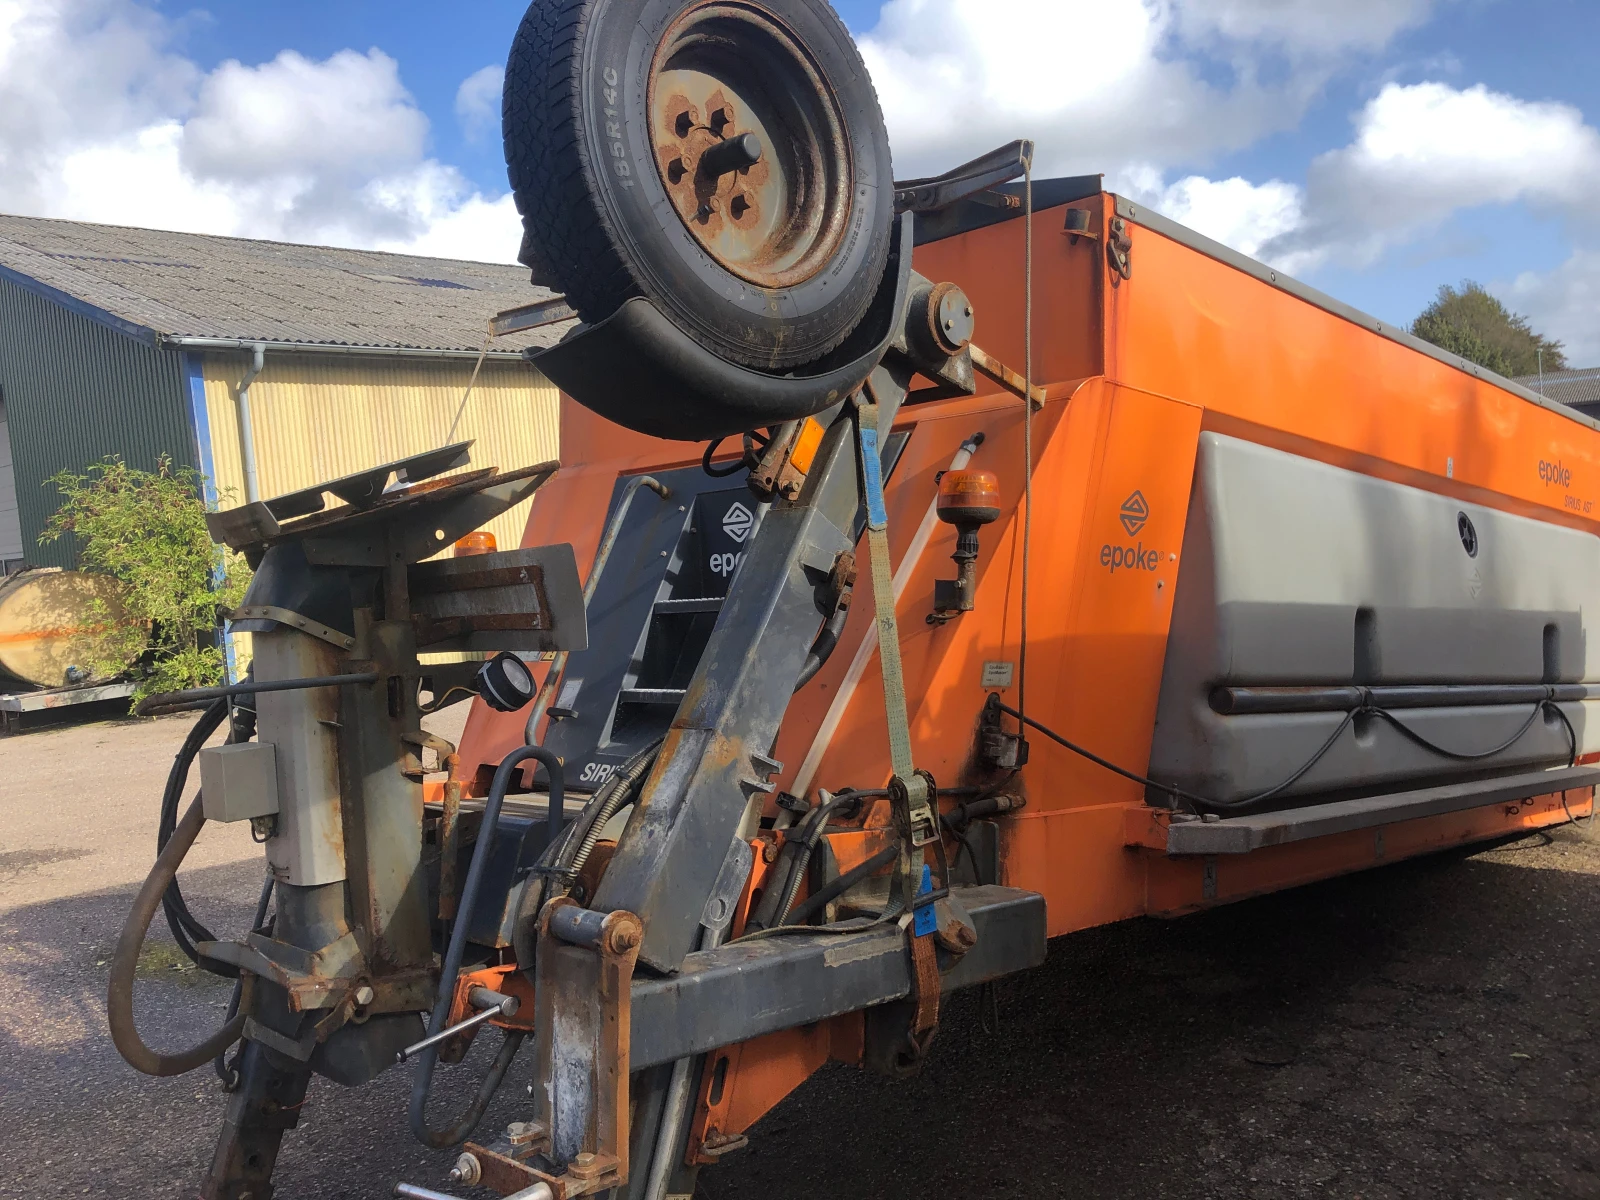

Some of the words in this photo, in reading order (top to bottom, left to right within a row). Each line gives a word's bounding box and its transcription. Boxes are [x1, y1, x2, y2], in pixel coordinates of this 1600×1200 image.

[602, 66, 635, 191] 185R14C
[1538, 459, 1570, 488] epoke
[1564, 495, 1581, 511] SIRIUS
